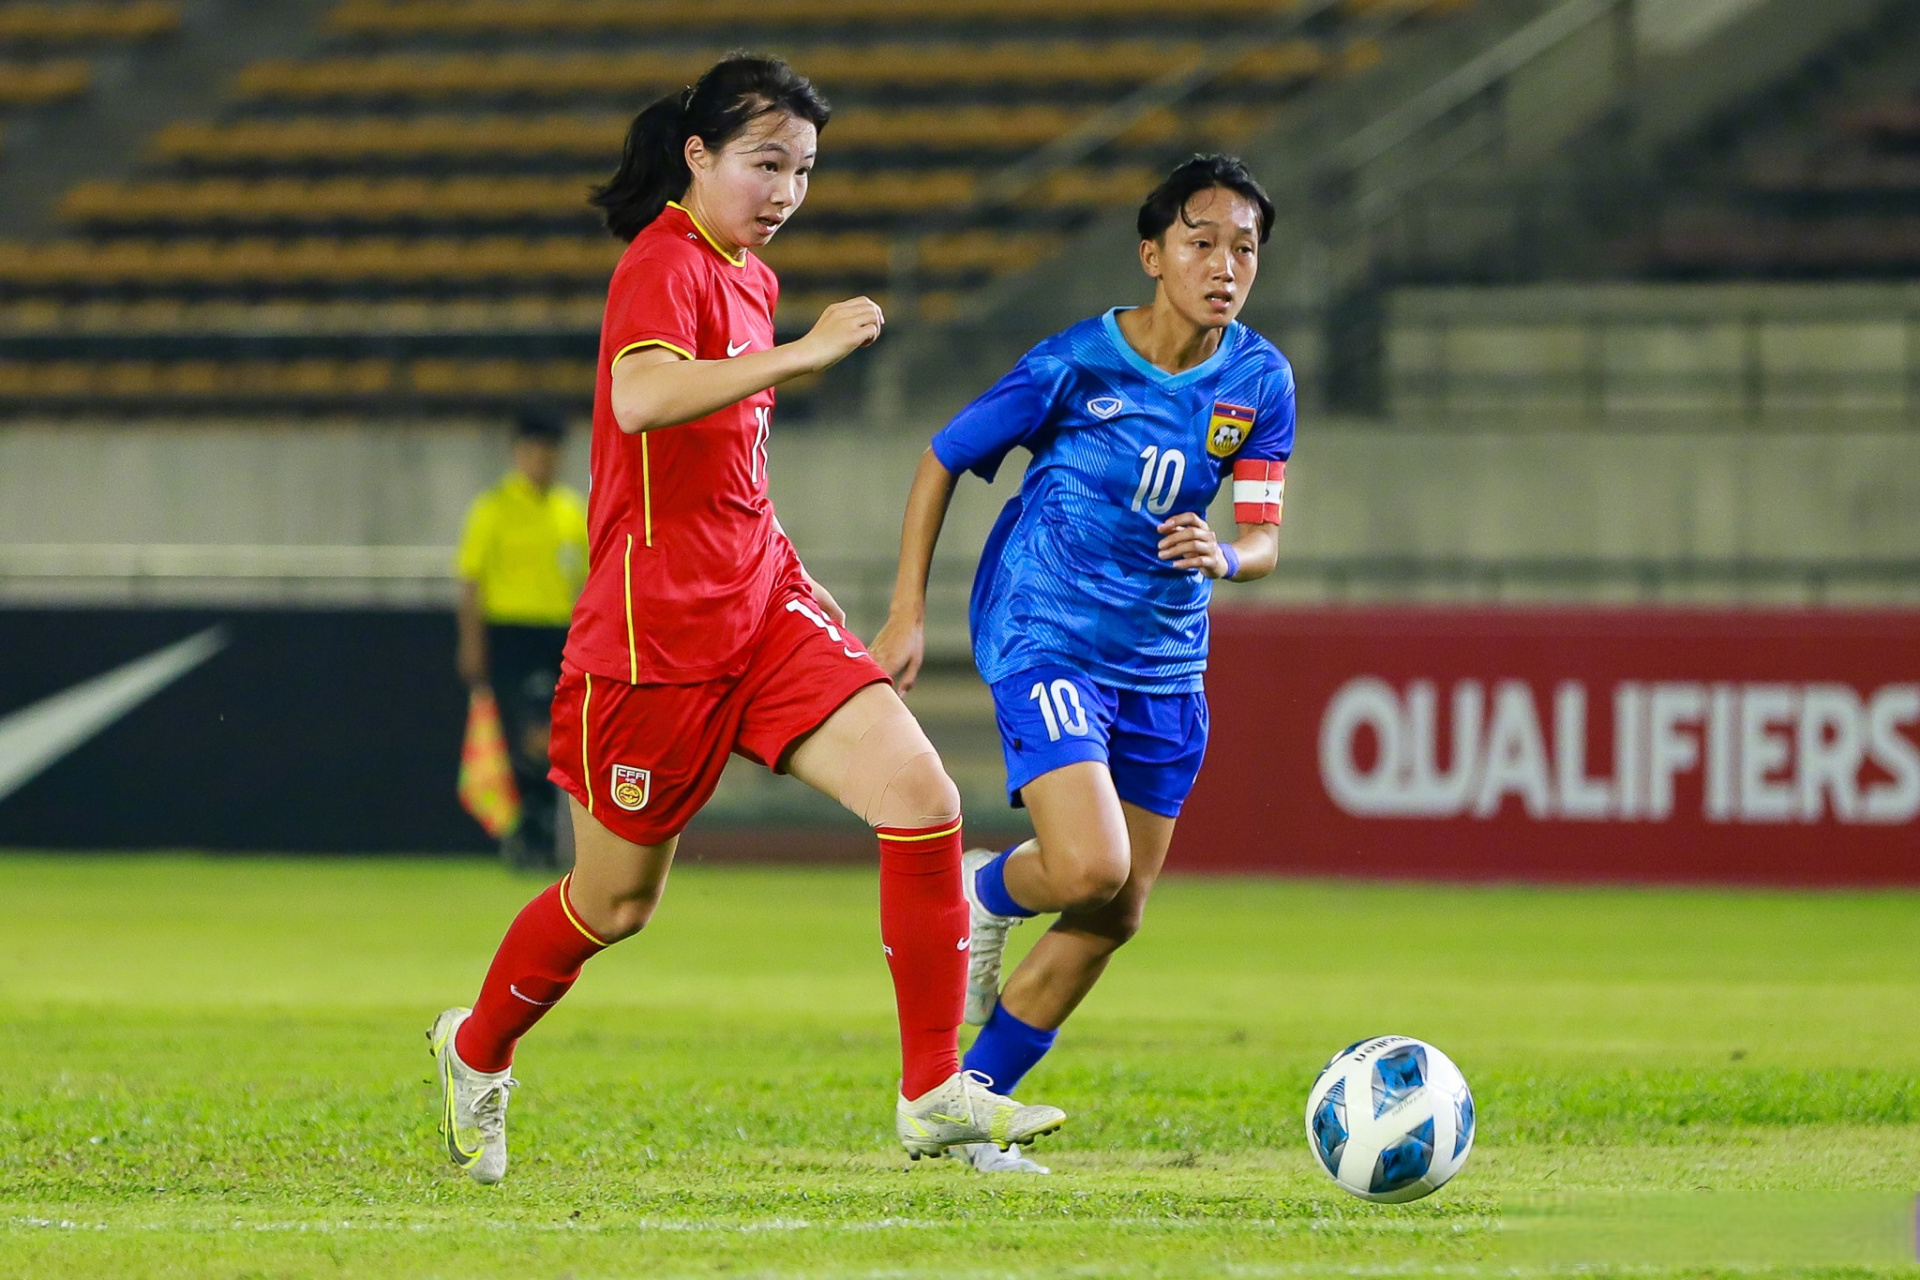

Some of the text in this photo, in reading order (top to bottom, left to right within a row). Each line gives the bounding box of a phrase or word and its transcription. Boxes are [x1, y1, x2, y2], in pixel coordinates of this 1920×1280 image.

[1131, 444, 1187, 515] 10
[785, 599, 842, 642] 1
[1029, 678, 1089, 742] 10
[617, 768, 645, 781] CFA
[1318, 675, 1920, 825] QUALIFIERS
